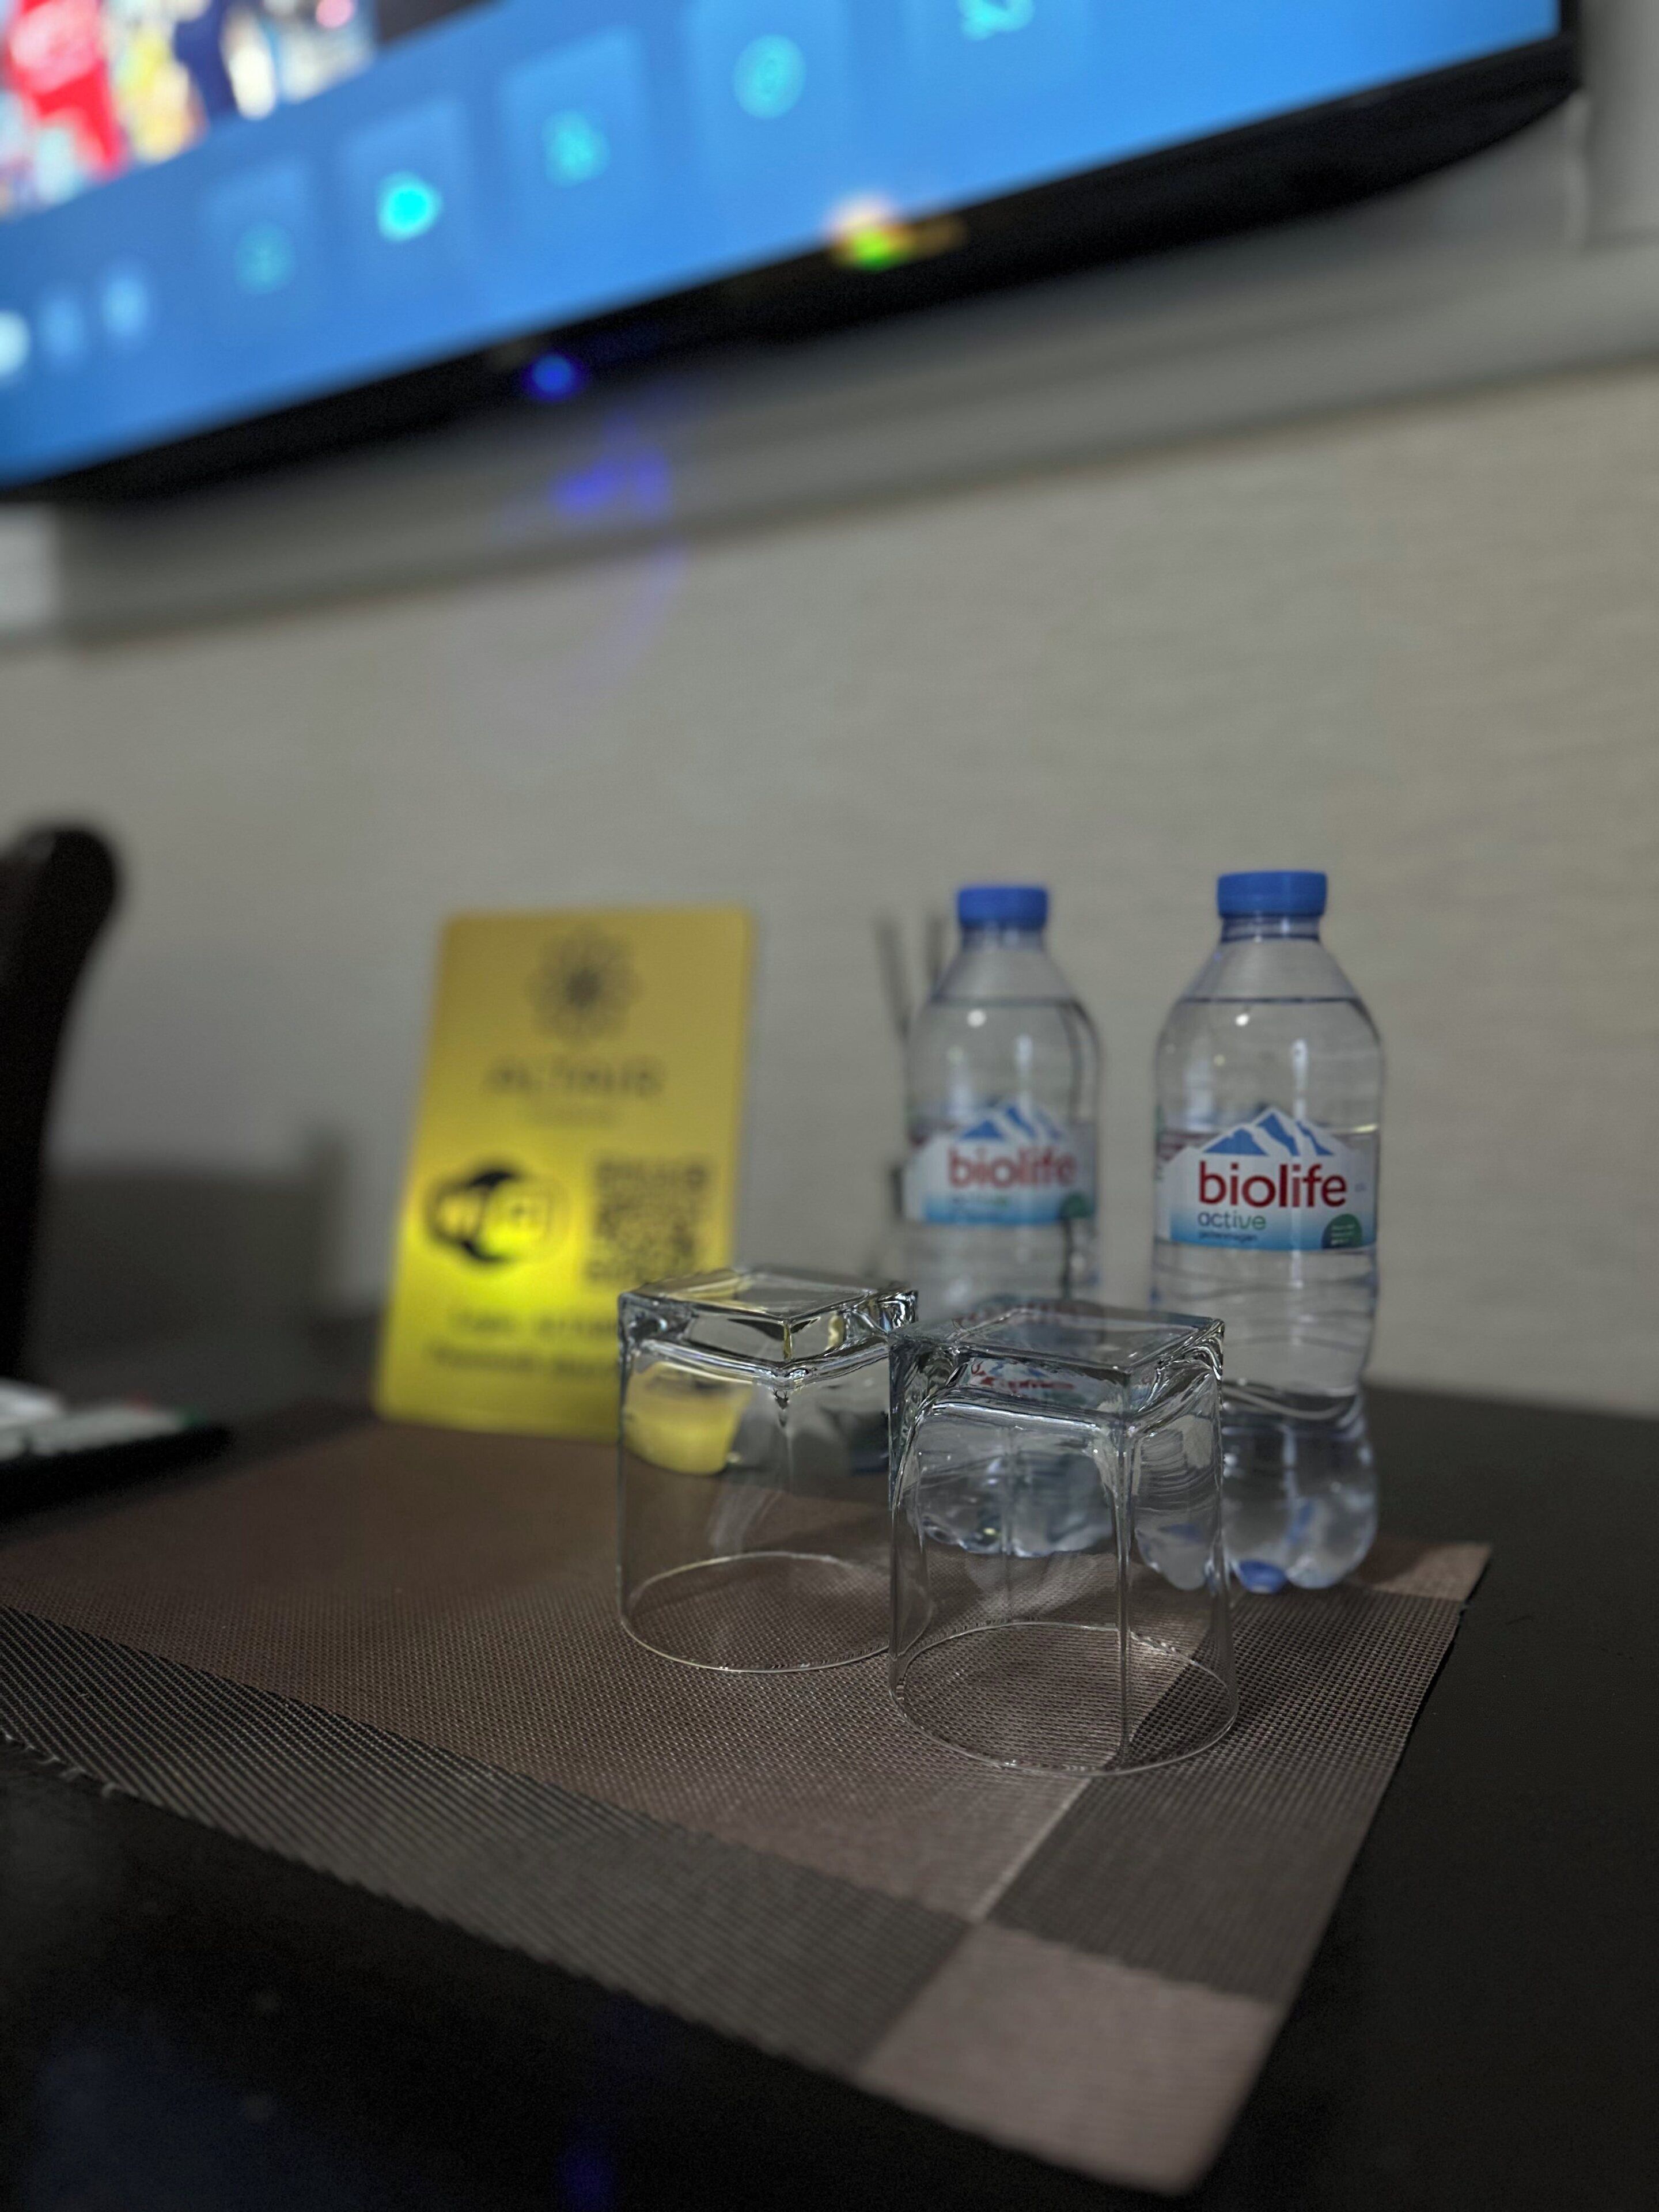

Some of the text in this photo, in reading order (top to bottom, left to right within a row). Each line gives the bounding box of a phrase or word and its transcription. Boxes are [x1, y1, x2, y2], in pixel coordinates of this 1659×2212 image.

[949, 1147, 1075, 1189] biolife
[1199, 1160, 1347, 1208] biolife
[1198, 1210, 1267, 1230] active
